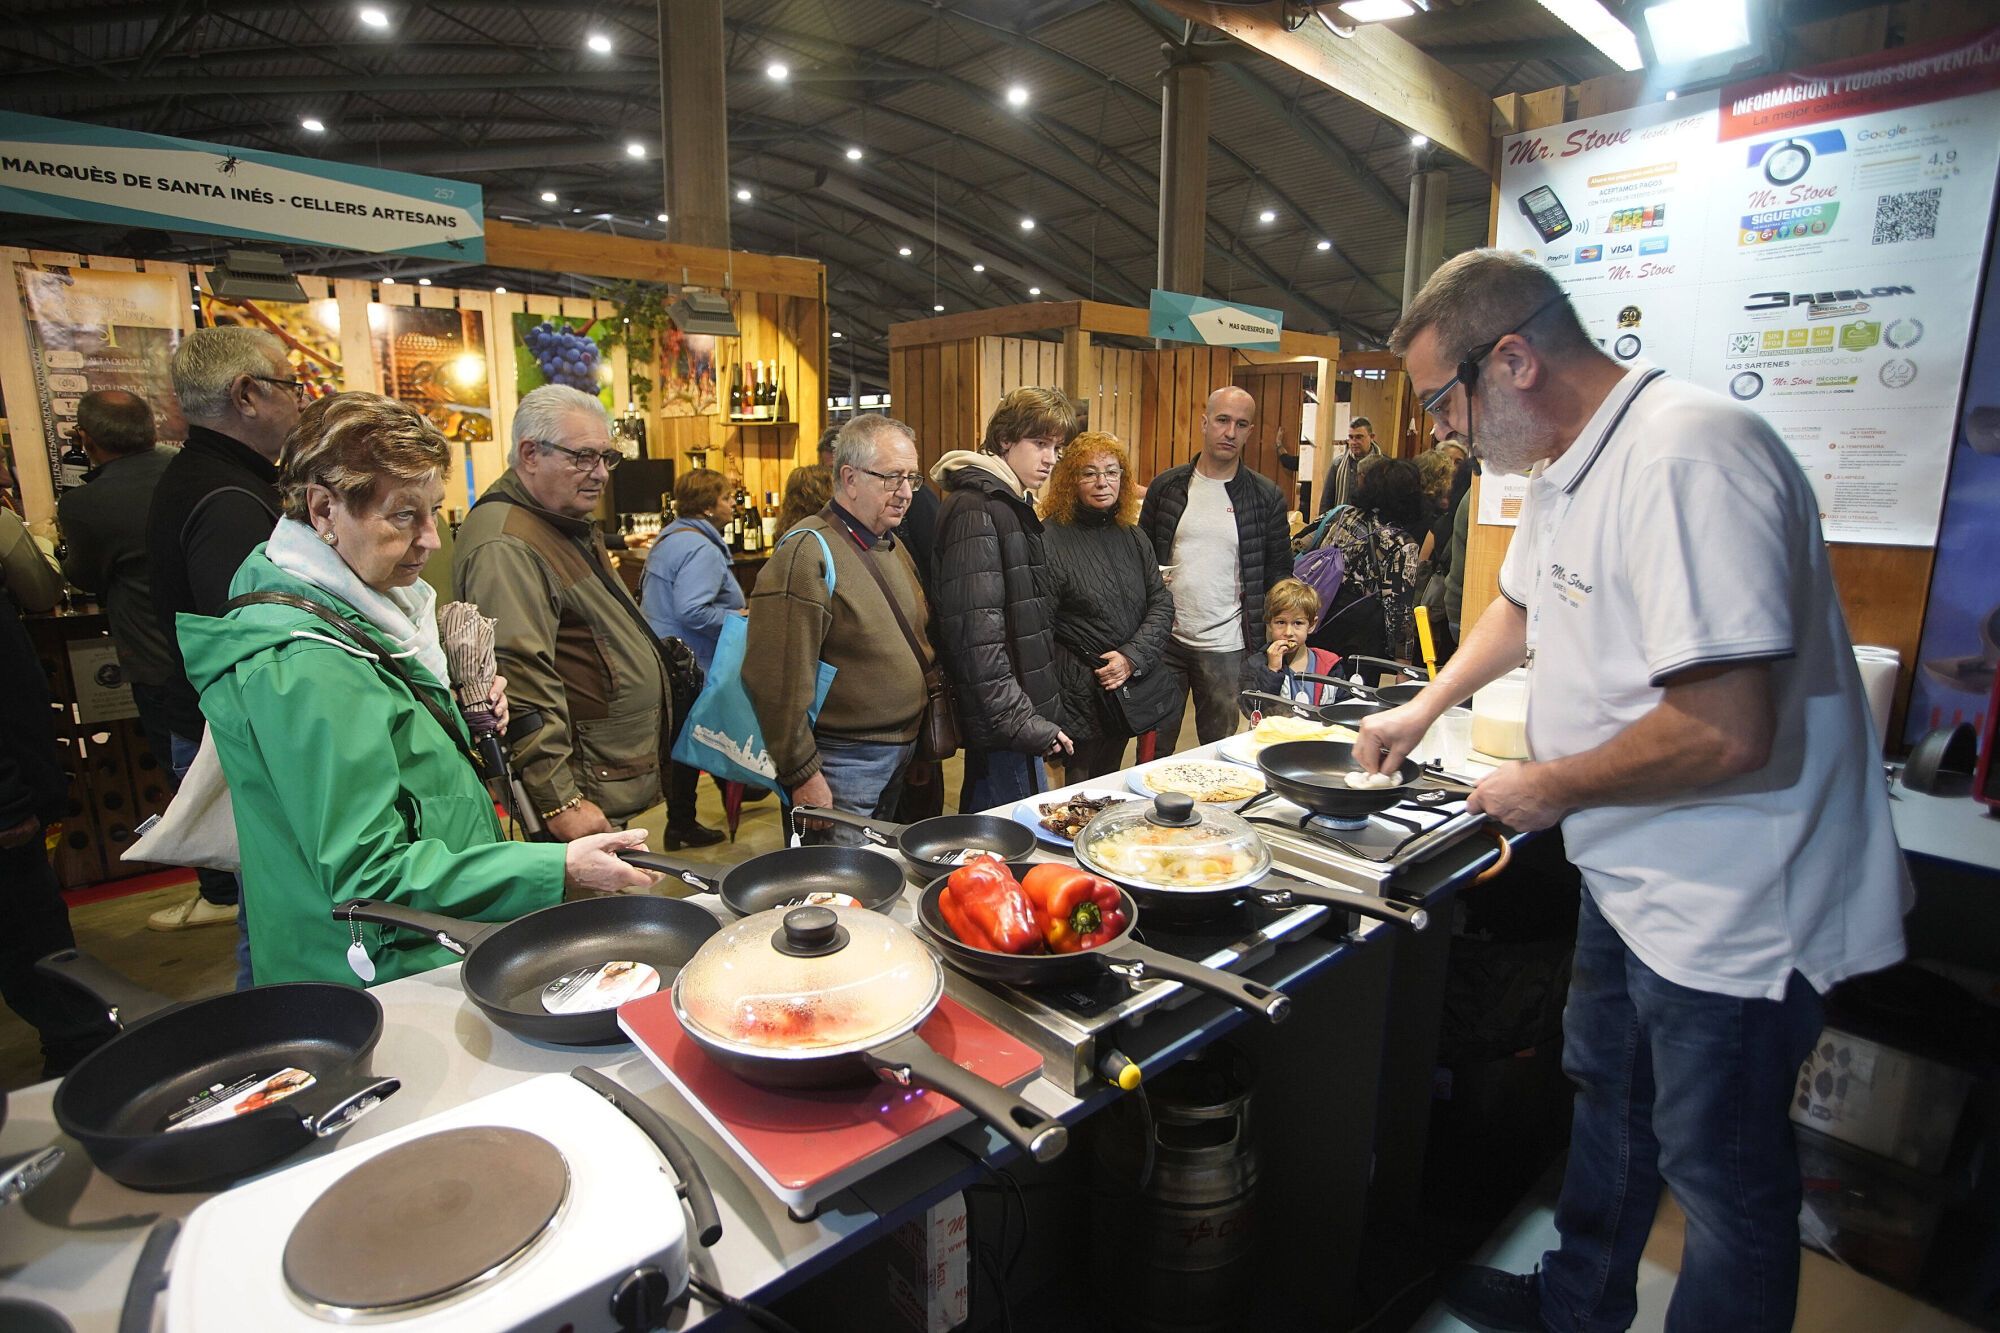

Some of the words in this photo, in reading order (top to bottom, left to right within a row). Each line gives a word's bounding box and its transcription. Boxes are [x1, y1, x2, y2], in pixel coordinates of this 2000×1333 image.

[1732, 80, 1828, 117] INFORMACIÓN
[1833, 78, 1842, 95] Y
[1771, 106, 1809, 123] mejor
[1856, 126, 1908, 142] Google
[1508, 137, 1554, 166] Mr.
[1560, 127, 1633, 158] Stove
[1, 156, 118, 185] MARQUÈS
[123, 172, 153, 190] DE
[157, 177, 226, 199] SANTA
[230, 187, 274, 205] INÉS
[290, 196, 368, 217] CELLERS
[372, 206, 457, 229] ARTESANS
[433, 187, 456, 199] 257
[1598, 183, 1639, 196] ACEPTAMOS
[1639, 179, 1664, 190] PAGOS
[1747, 189, 1782, 209] Mr.
[1785, 184, 1838, 207] Stove
[1546, 253, 1570, 262] PayPal
[1610, 244, 1633, 255] VISA
[1608, 265, 1634, 281] Mr.
[1637, 262, 1676, 280] Stove
[1621, 310, 1638, 323] 30
[1228, 321, 1240, 330] MAS
[1240, 323, 1266, 334] QUESEROS
[1725, 361, 1743, 371] LAS
[1744, 360, 1790, 370] SARTENES
[1790, 377, 1814, 386] Stove
